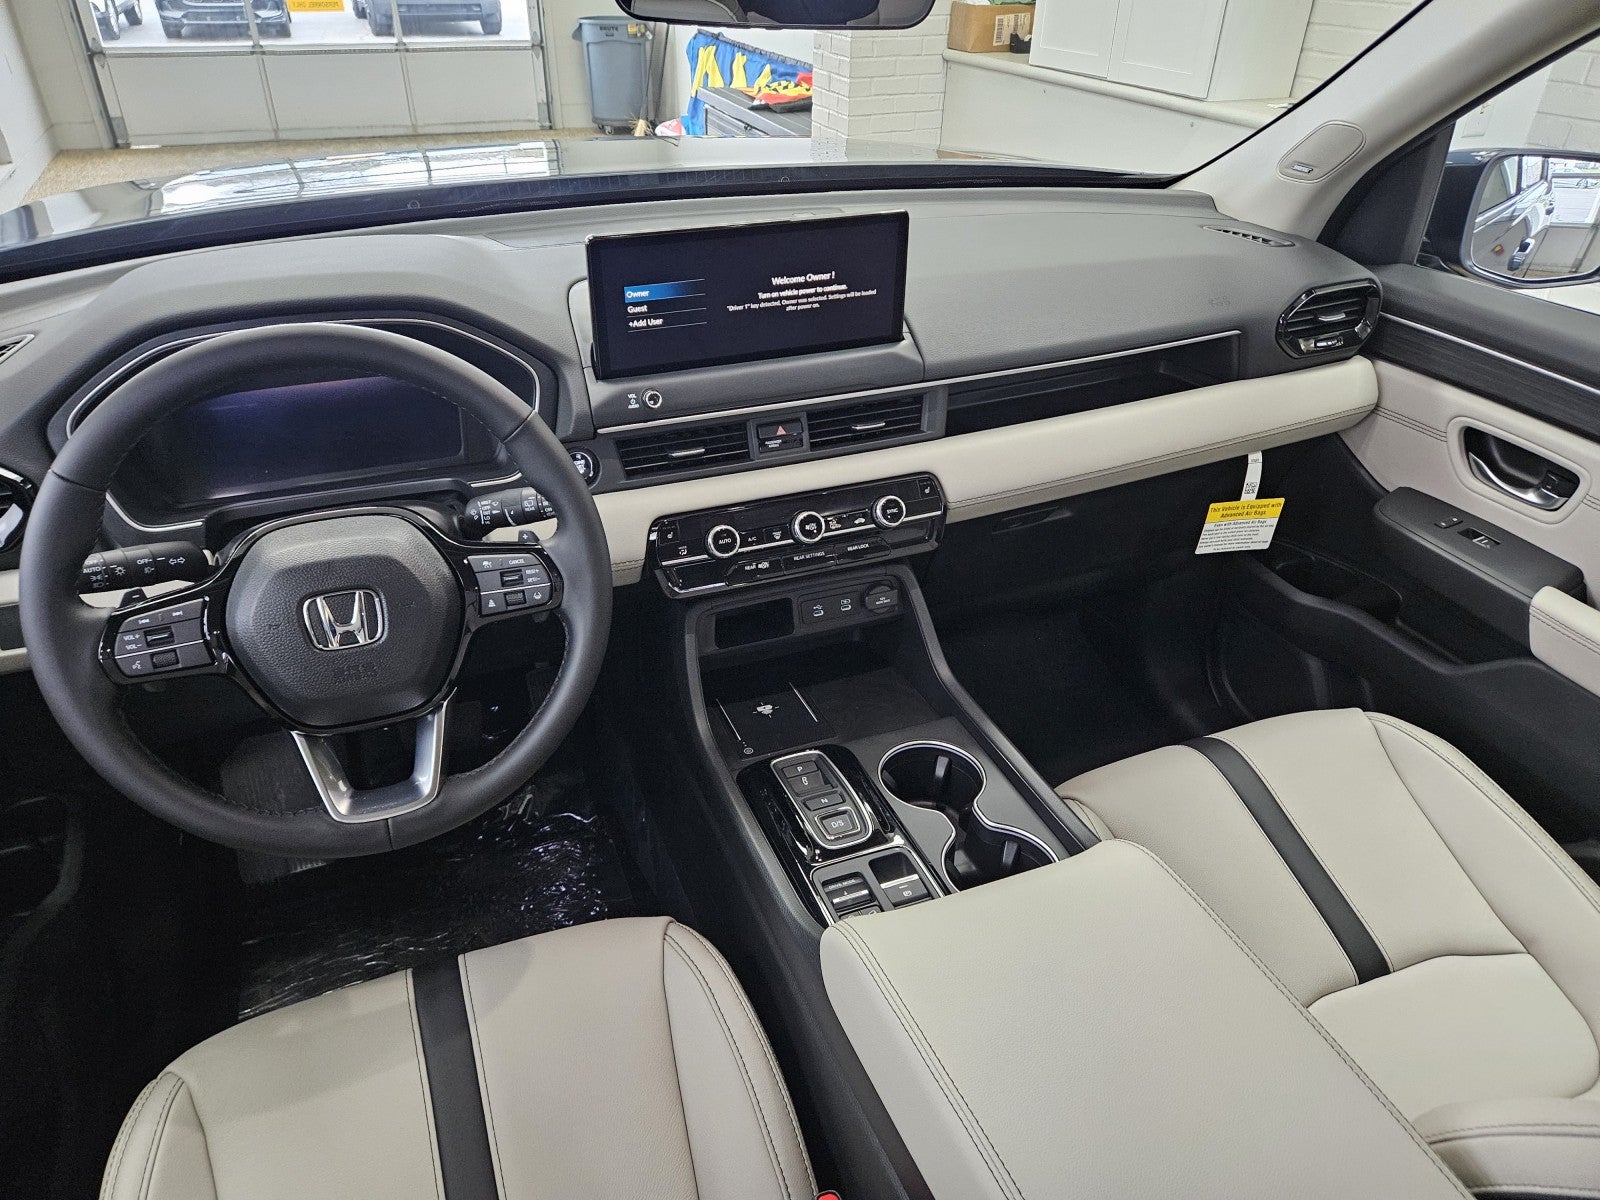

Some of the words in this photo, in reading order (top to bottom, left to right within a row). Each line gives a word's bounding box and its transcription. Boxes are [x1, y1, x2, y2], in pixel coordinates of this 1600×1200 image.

[771, 274, 805, 286] Welcome
[806, 272, 831, 282] Owner
[626, 290, 650, 298] Owner
[758, 290, 771, 300] Turn
[780, 288, 799, 298] vehicle
[799, 287, 816, 296] power
[824, 283, 848, 292] continue.
[627, 304, 648, 314] Guest
[750, 302, 760, 310] key
[648, 318, 664, 326] User
